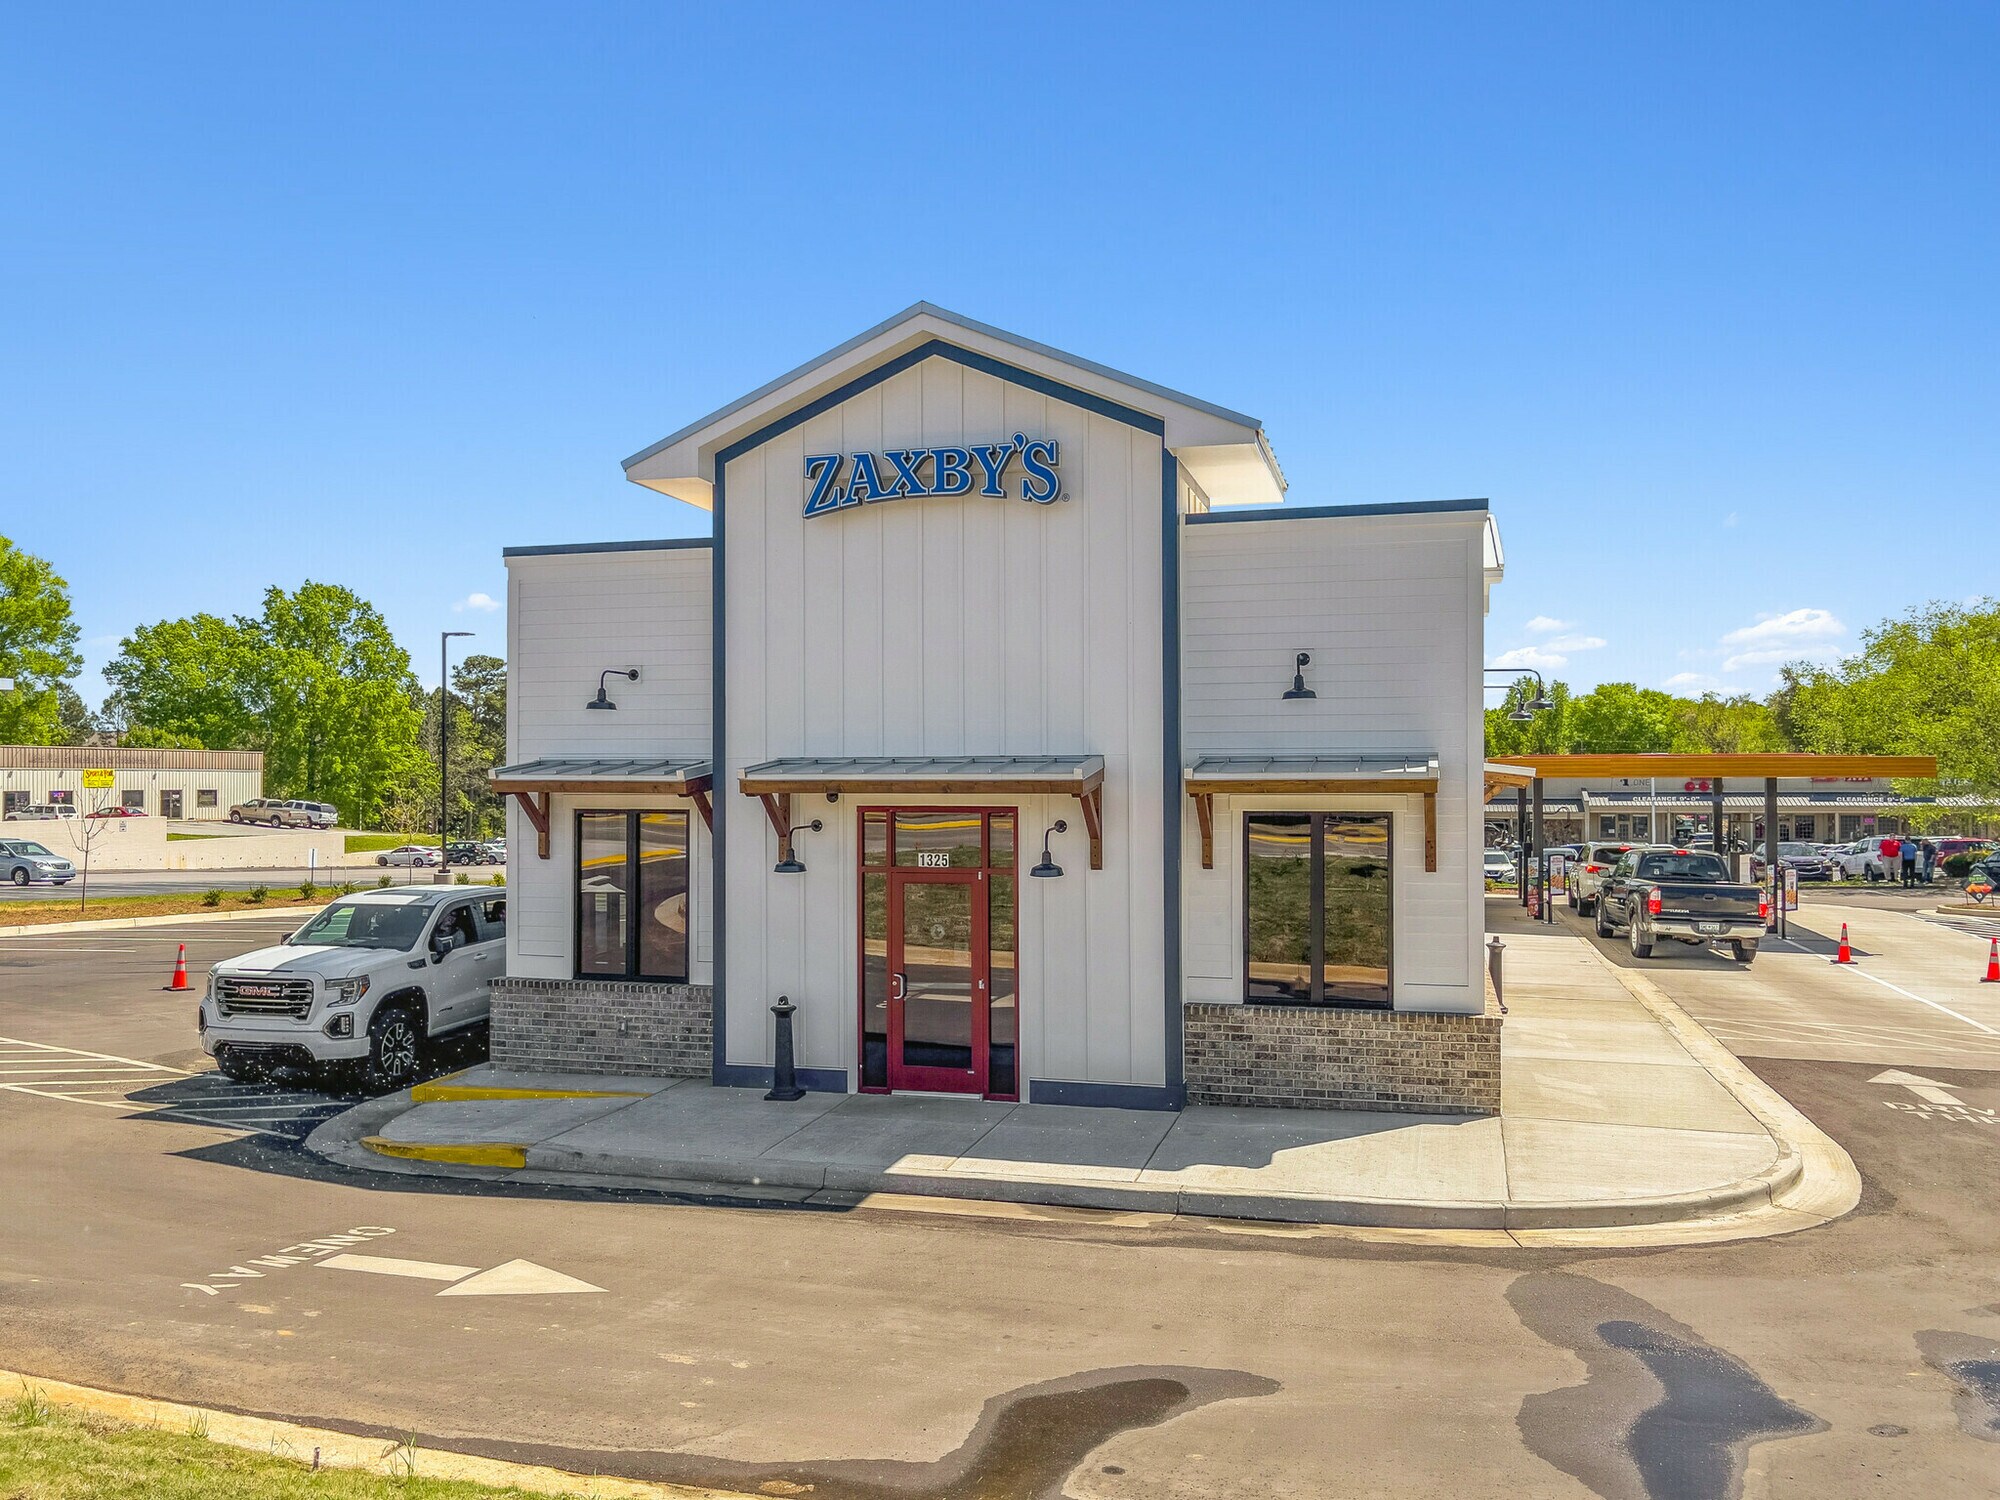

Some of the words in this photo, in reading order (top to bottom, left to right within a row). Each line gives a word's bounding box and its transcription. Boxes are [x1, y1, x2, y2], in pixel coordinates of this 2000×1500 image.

[802, 431, 1060, 519] ZAXBY'S
[920, 853, 948, 867] 1325
[239, 985, 280, 997] GMC
